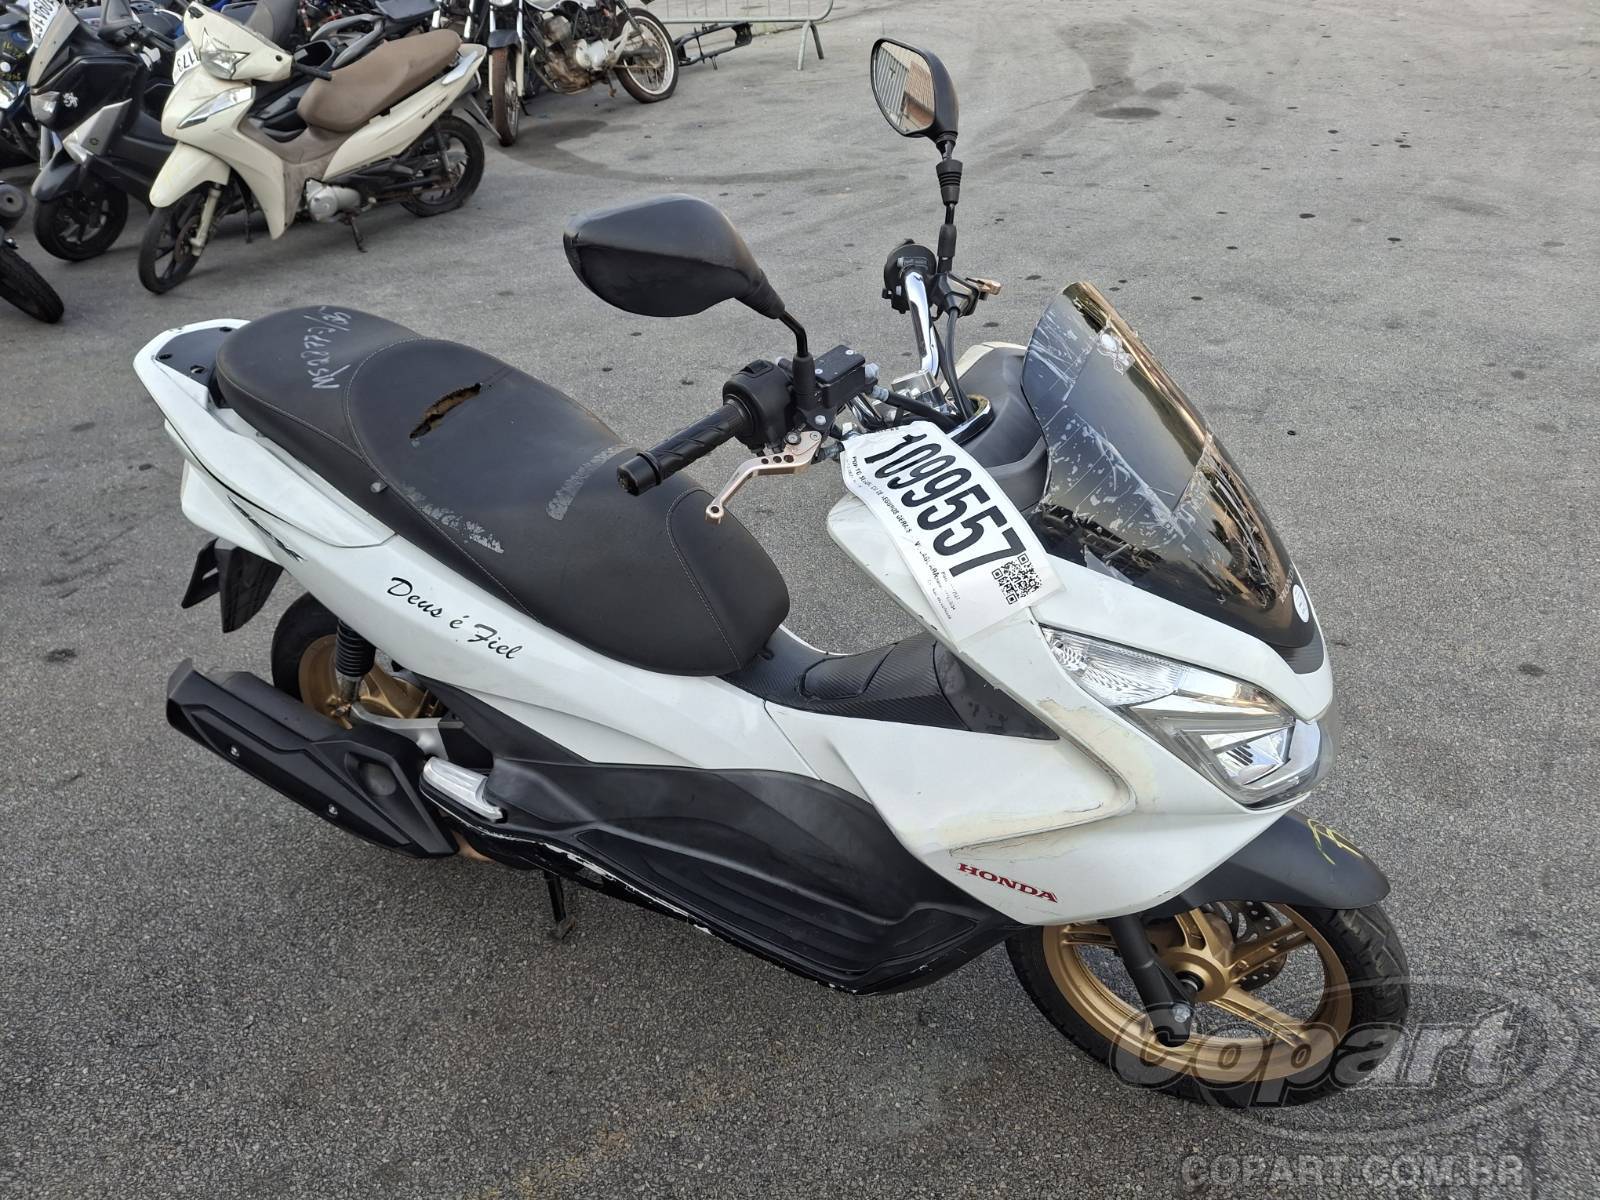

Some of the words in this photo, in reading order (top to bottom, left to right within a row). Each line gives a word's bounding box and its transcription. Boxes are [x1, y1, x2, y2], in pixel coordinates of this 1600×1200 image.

[864, 434, 1026, 577] 1099557
[387, 577, 442, 617] Deus
[449, 615, 470, 629] é
[467, 623, 523, 659] Fiel
[957, 862, 1058, 903] HONDA
